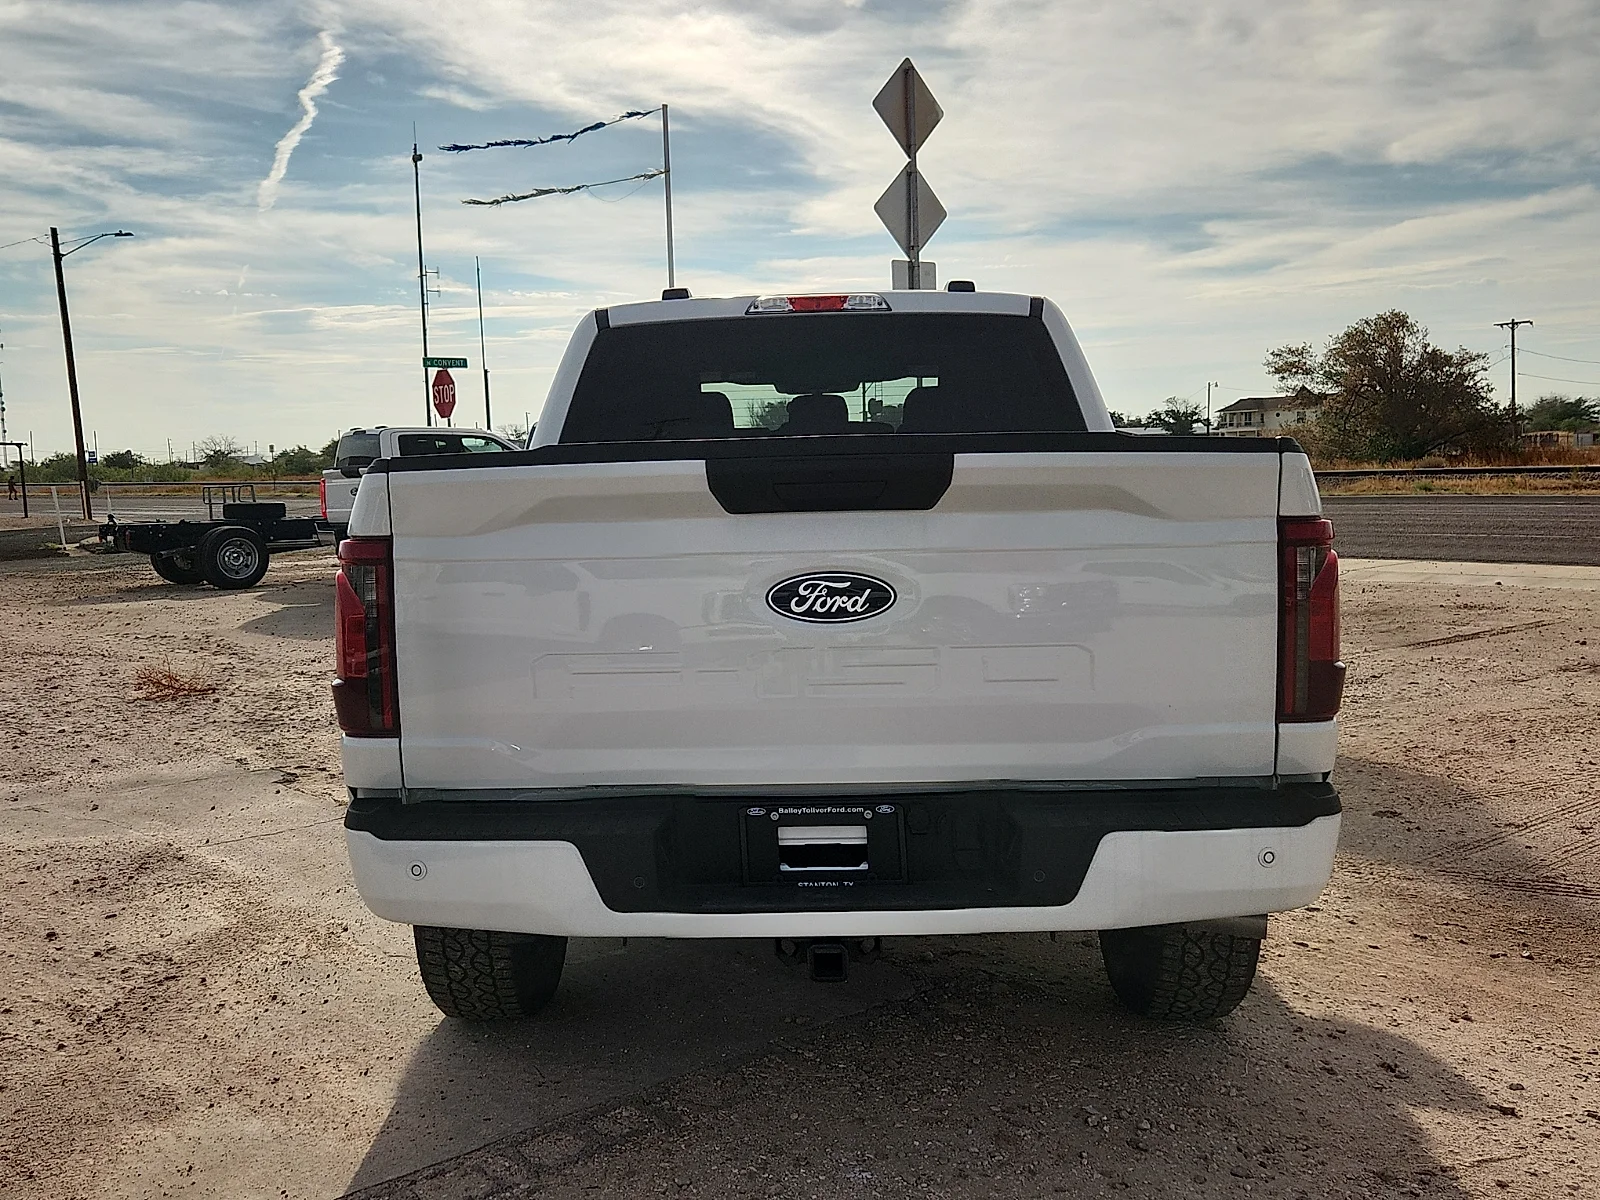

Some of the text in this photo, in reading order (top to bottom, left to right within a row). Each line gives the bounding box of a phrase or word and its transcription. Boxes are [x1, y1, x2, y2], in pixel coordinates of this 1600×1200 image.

[433, 359, 464, 367] CONVENT
[434, 384, 454, 405] STOP
[790, 580, 872, 613] Ford
